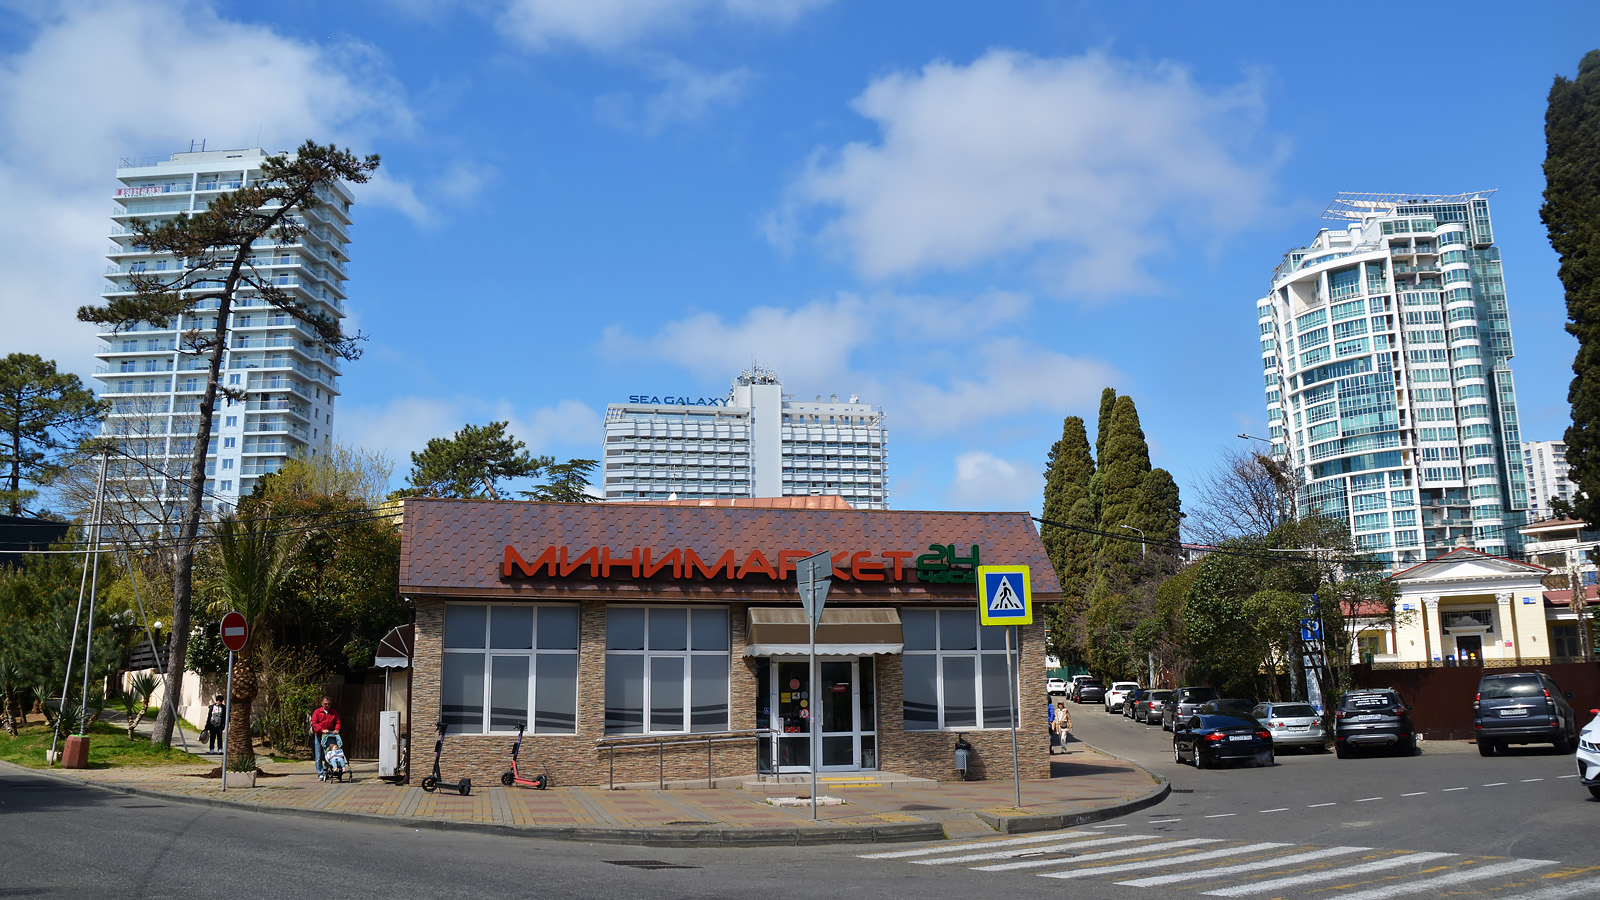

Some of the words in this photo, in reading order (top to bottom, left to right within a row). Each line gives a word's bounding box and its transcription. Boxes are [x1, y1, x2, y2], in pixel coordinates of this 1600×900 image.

[629, 395, 662, 404] SEA
[663, 396, 730, 407] GALAXY
[916, 543, 980, 570] 24
